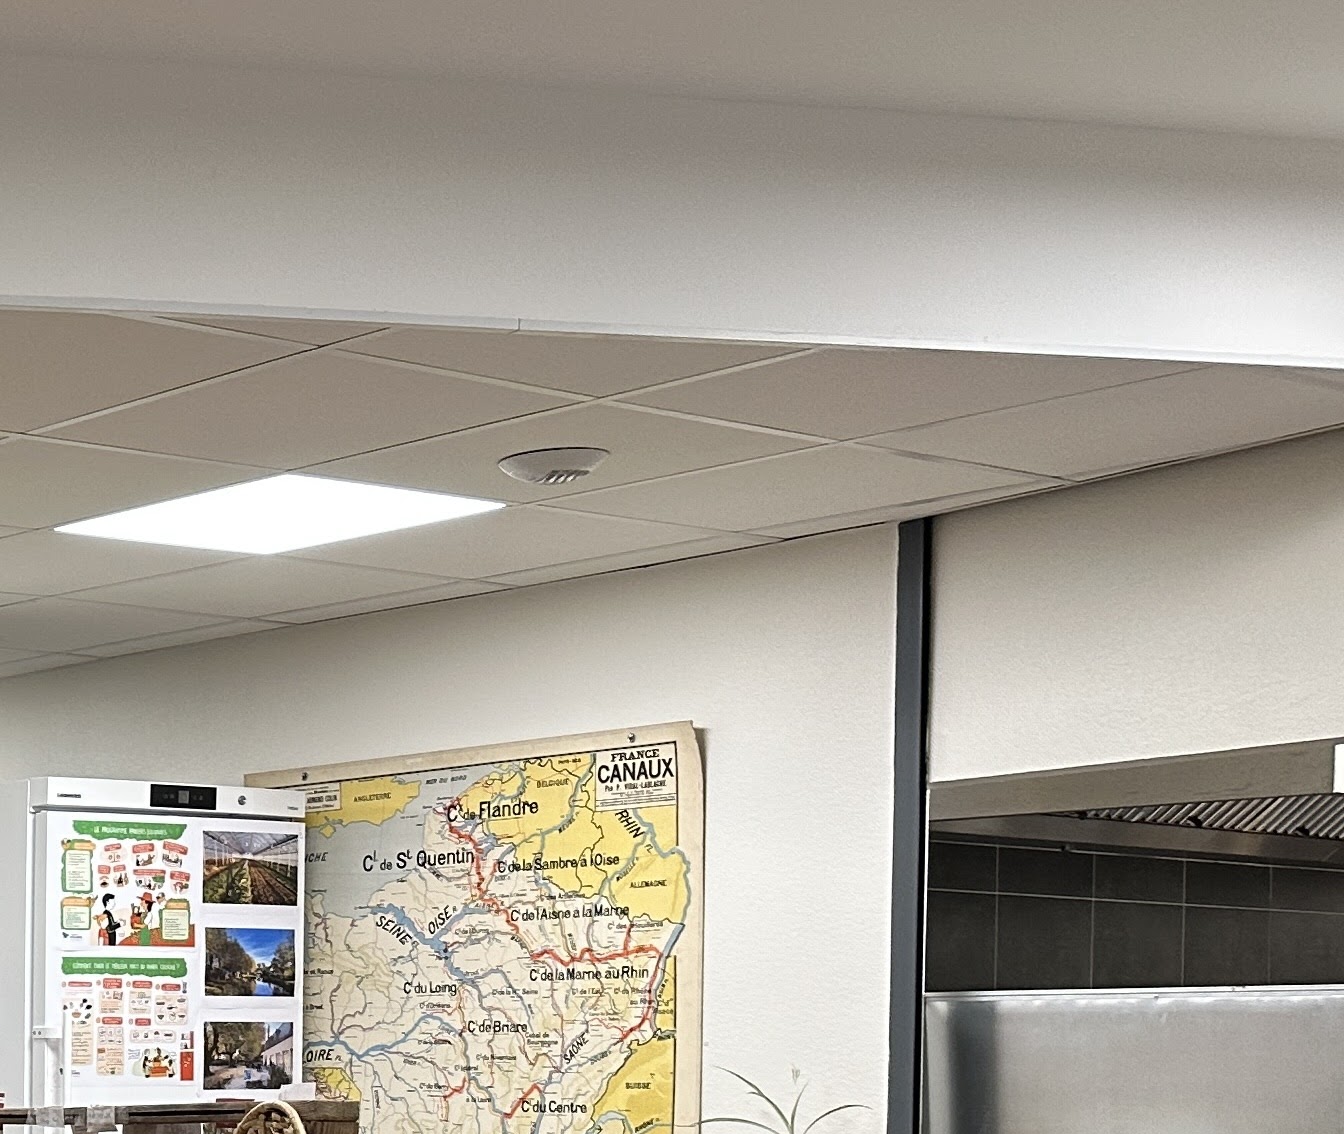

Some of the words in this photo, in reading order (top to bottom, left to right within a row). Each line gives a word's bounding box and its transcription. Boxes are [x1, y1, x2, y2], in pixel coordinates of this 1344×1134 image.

[610, 749, 659, 762] FRANCE
[597, 758, 674, 784] CANAUX
[536, 778, 569, 788] BELGIQUE
[353, 792, 392, 802] ANGLETERRE
[463, 810, 475, 820] de
[479, 800, 539, 820] Flandre
[615, 809, 645, 839] RHIN
[380, 859, 392, 870] de
[396, 850, 412, 869] St
[417, 850, 475, 869] Quentin
[534, 856, 578, 872] Sambre
[629, 879, 668, 888] ALLEMAGNE
[582, 905, 592, 917] la
[594, 902, 630, 917] Marne
[428, 905, 450, 935] OISE
[375, 916, 413, 946] SEINE
[555, 968, 565, 980] la
[566, 968, 602, 980] Marne
[605, 969, 620, 980] au
[621, 965, 649, 979] Rhin
[414, 982, 428, 994] du
[430, 982, 457, 997] Loing
[493, 1020, 527, 1033] Briare
[533, 1101, 546, 1113] du
[548, 1101, 587, 1113] Centre
